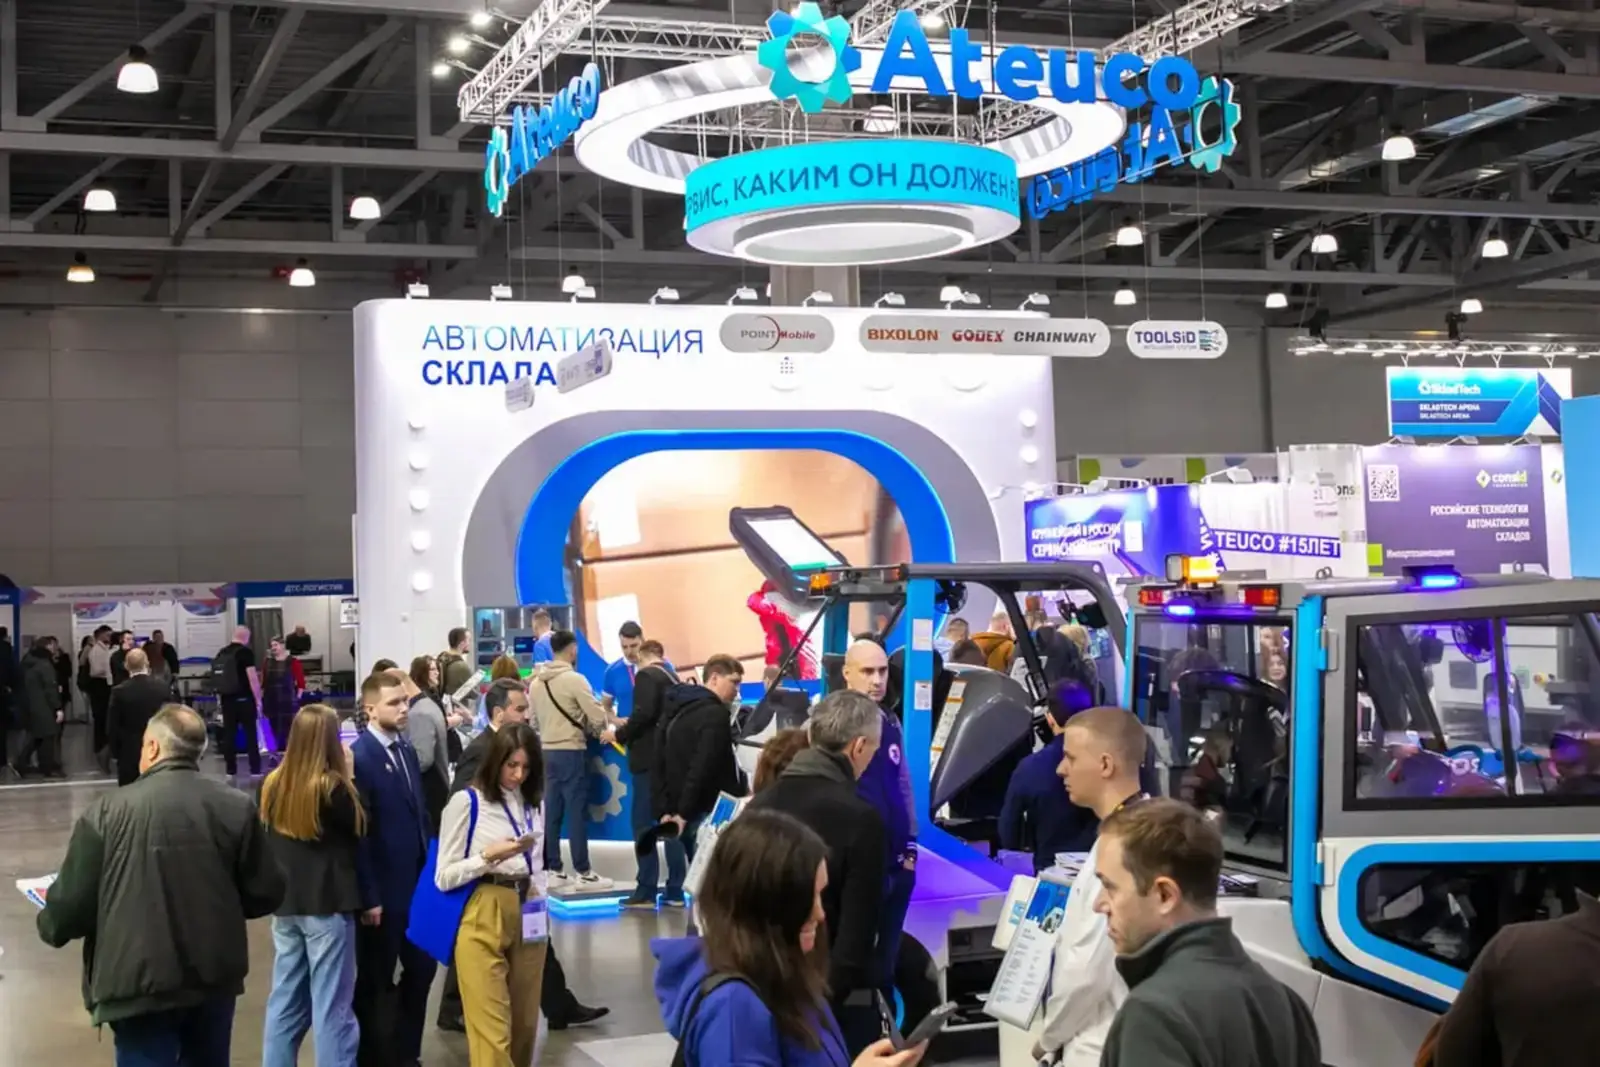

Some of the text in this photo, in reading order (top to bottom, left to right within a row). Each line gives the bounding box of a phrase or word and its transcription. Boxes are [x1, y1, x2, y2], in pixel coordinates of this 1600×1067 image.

[871, 9, 1199, 109] Ateuco
[733, 165, 838, 200] КАКИМ
[849, 163, 897, 188] ОН
[906, 163, 1008, 200] ДОЛЖЕН
[422, 325, 703, 358] АВТОМАТИЗАЦИЯ
[741, 330, 816, 340] POINT Mobile
[867, 329, 1097, 343] BIXOLON GODEX CHAINWAY
[1279, 535, 1341, 556] #15ЛЕТ
